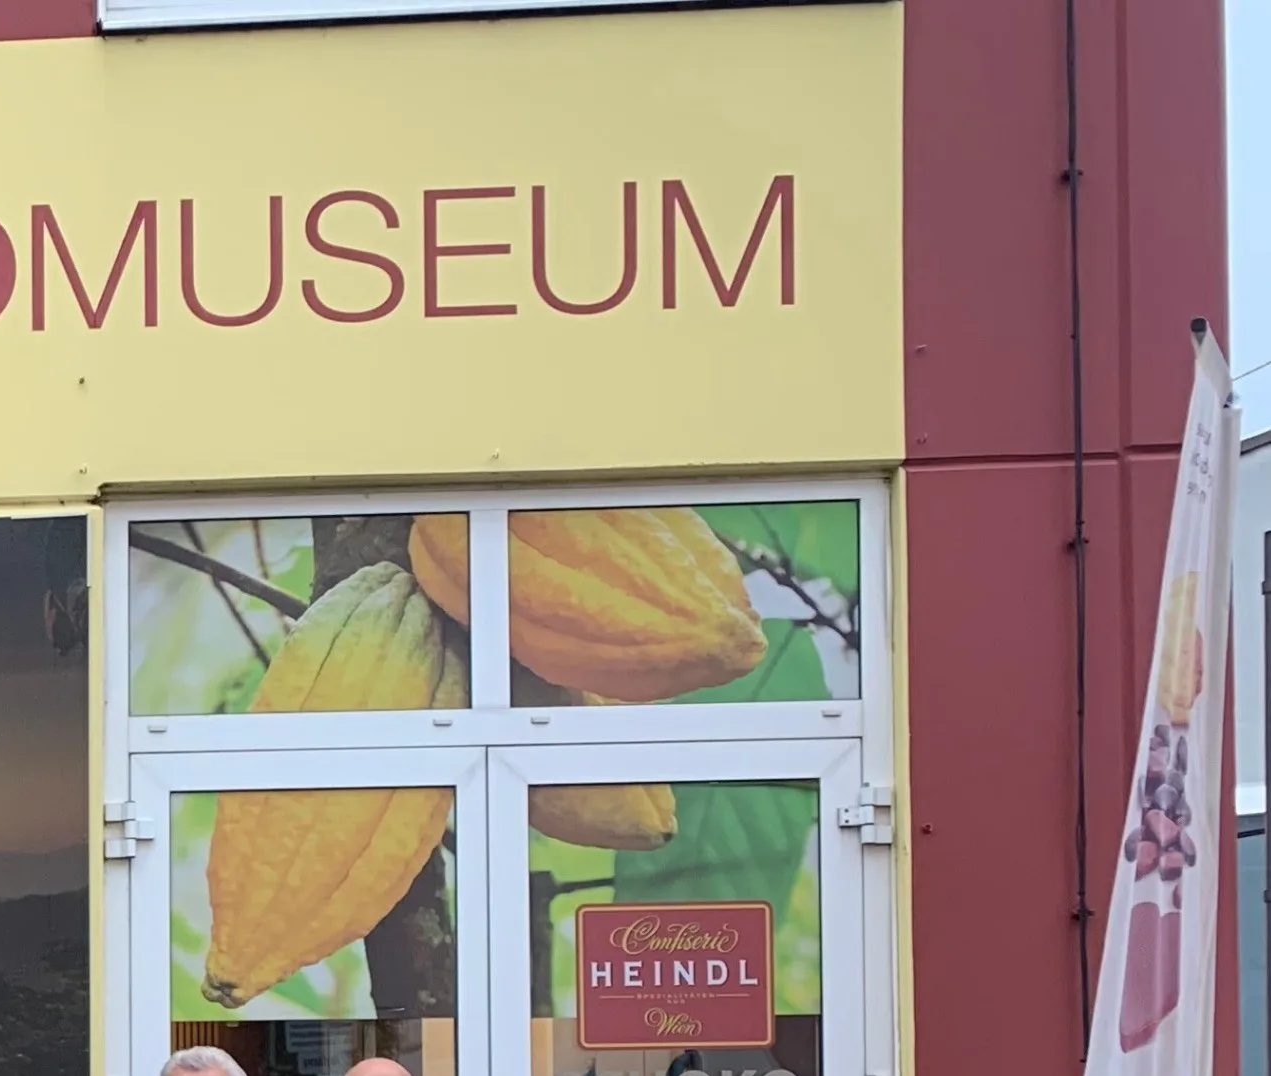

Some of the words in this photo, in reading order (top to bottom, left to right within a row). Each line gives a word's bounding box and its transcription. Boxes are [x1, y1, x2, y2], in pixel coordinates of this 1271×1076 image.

[609, 914, 739, 956] Confiserie
[590, 959, 759, 988] HEINDL
[644, 1007, 703, 1037] Wien
